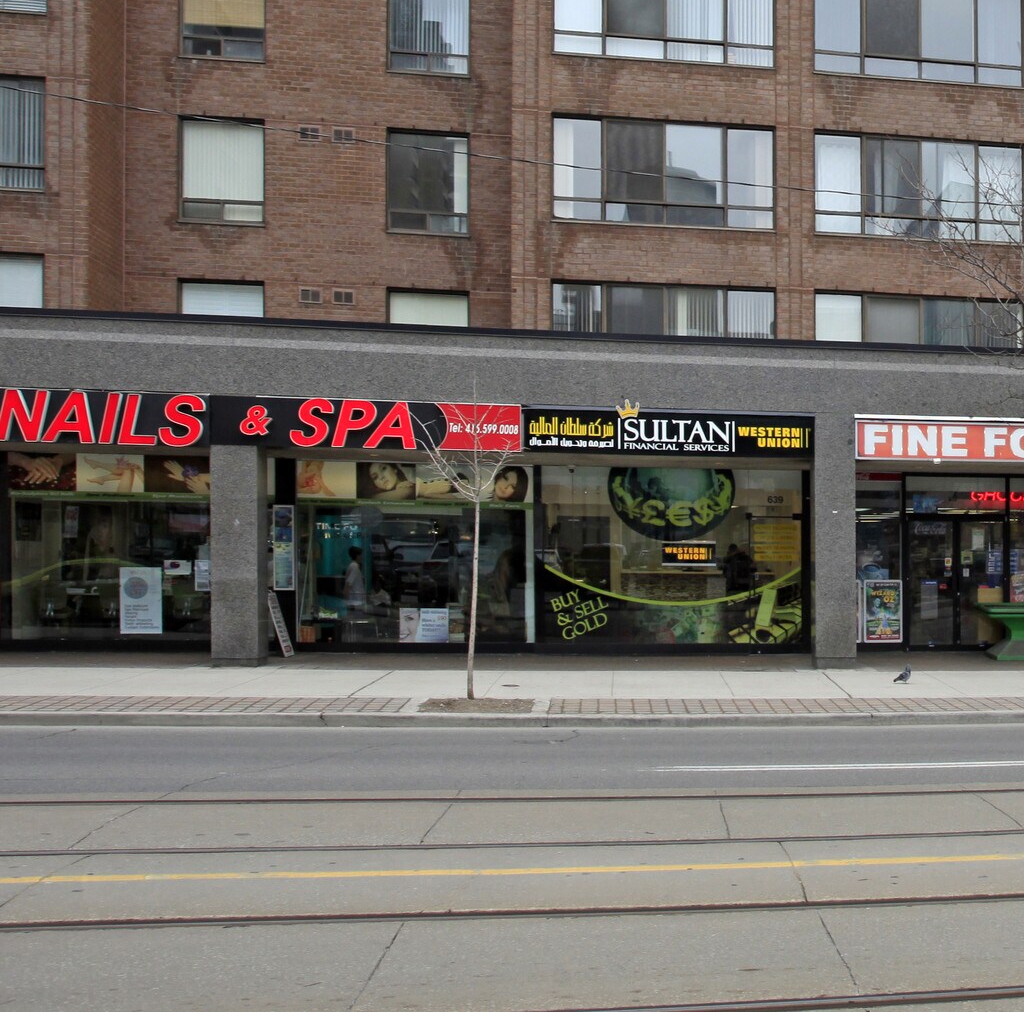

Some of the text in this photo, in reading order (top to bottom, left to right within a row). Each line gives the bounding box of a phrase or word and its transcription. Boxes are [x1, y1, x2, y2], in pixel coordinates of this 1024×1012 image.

[0, 388, 417, 450] NAILS & SPA
[449, 422, 463, 433] Tel:
[624, 418, 731, 444] SULTAN
[738, 426, 800, 438] WESTERN
[863, 424, 968, 457] FINE
[624, 443, 730, 452] FINANCIAL SERVICES
[757, 438, 800, 448] UNION
[767, 495, 784, 504] 639
[550, 589, 580, 612] BUY
[557, 596, 609, 626] & SELL
[562, 612, 608, 639] GOLD
